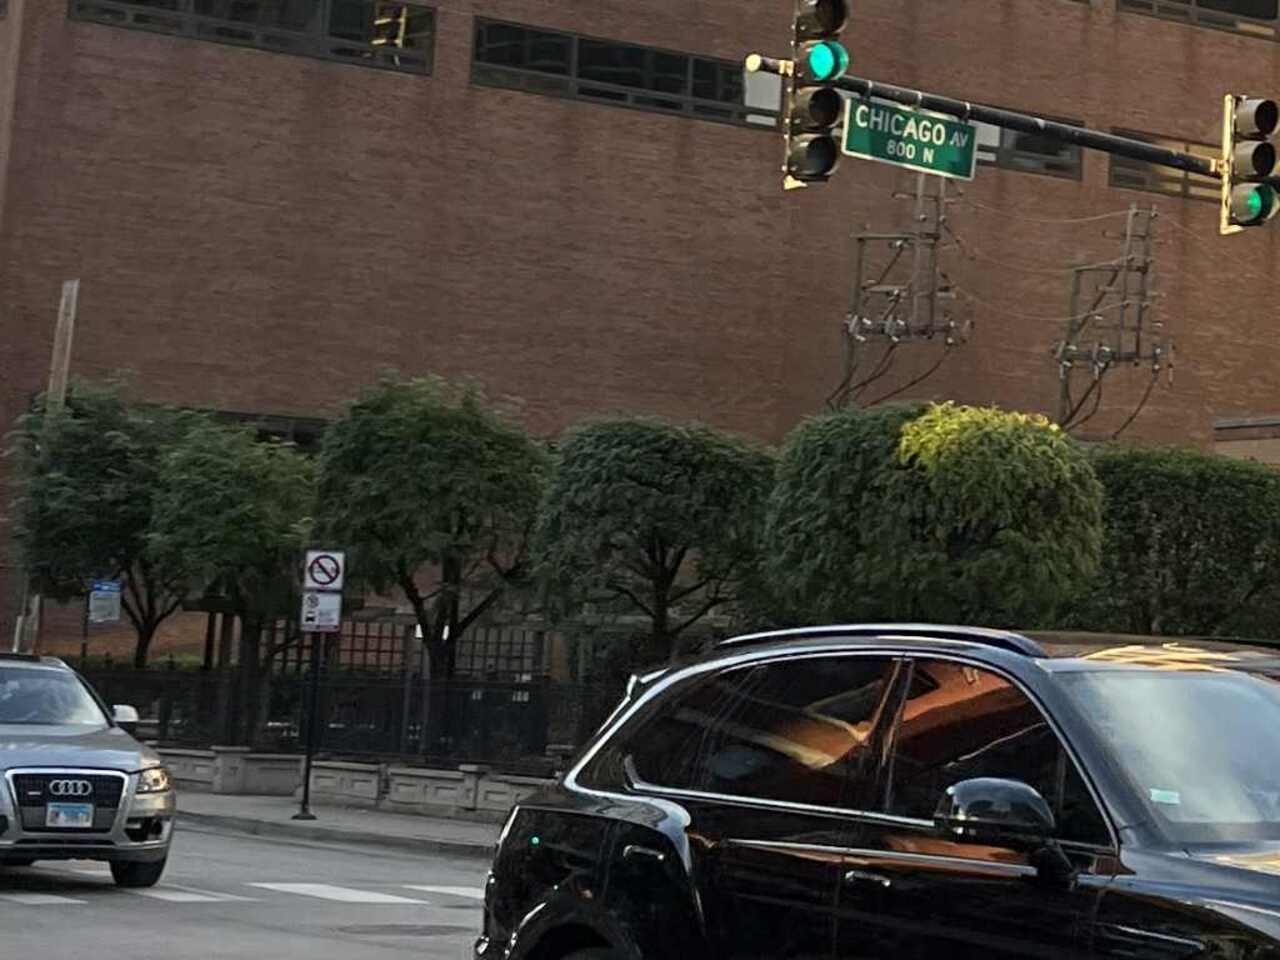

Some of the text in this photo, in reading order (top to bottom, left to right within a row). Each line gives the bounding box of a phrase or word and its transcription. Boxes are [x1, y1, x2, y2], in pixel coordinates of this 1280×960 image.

[855, 104, 969, 147] CHICAGO AV
[886, 139, 935, 164] 800 N
